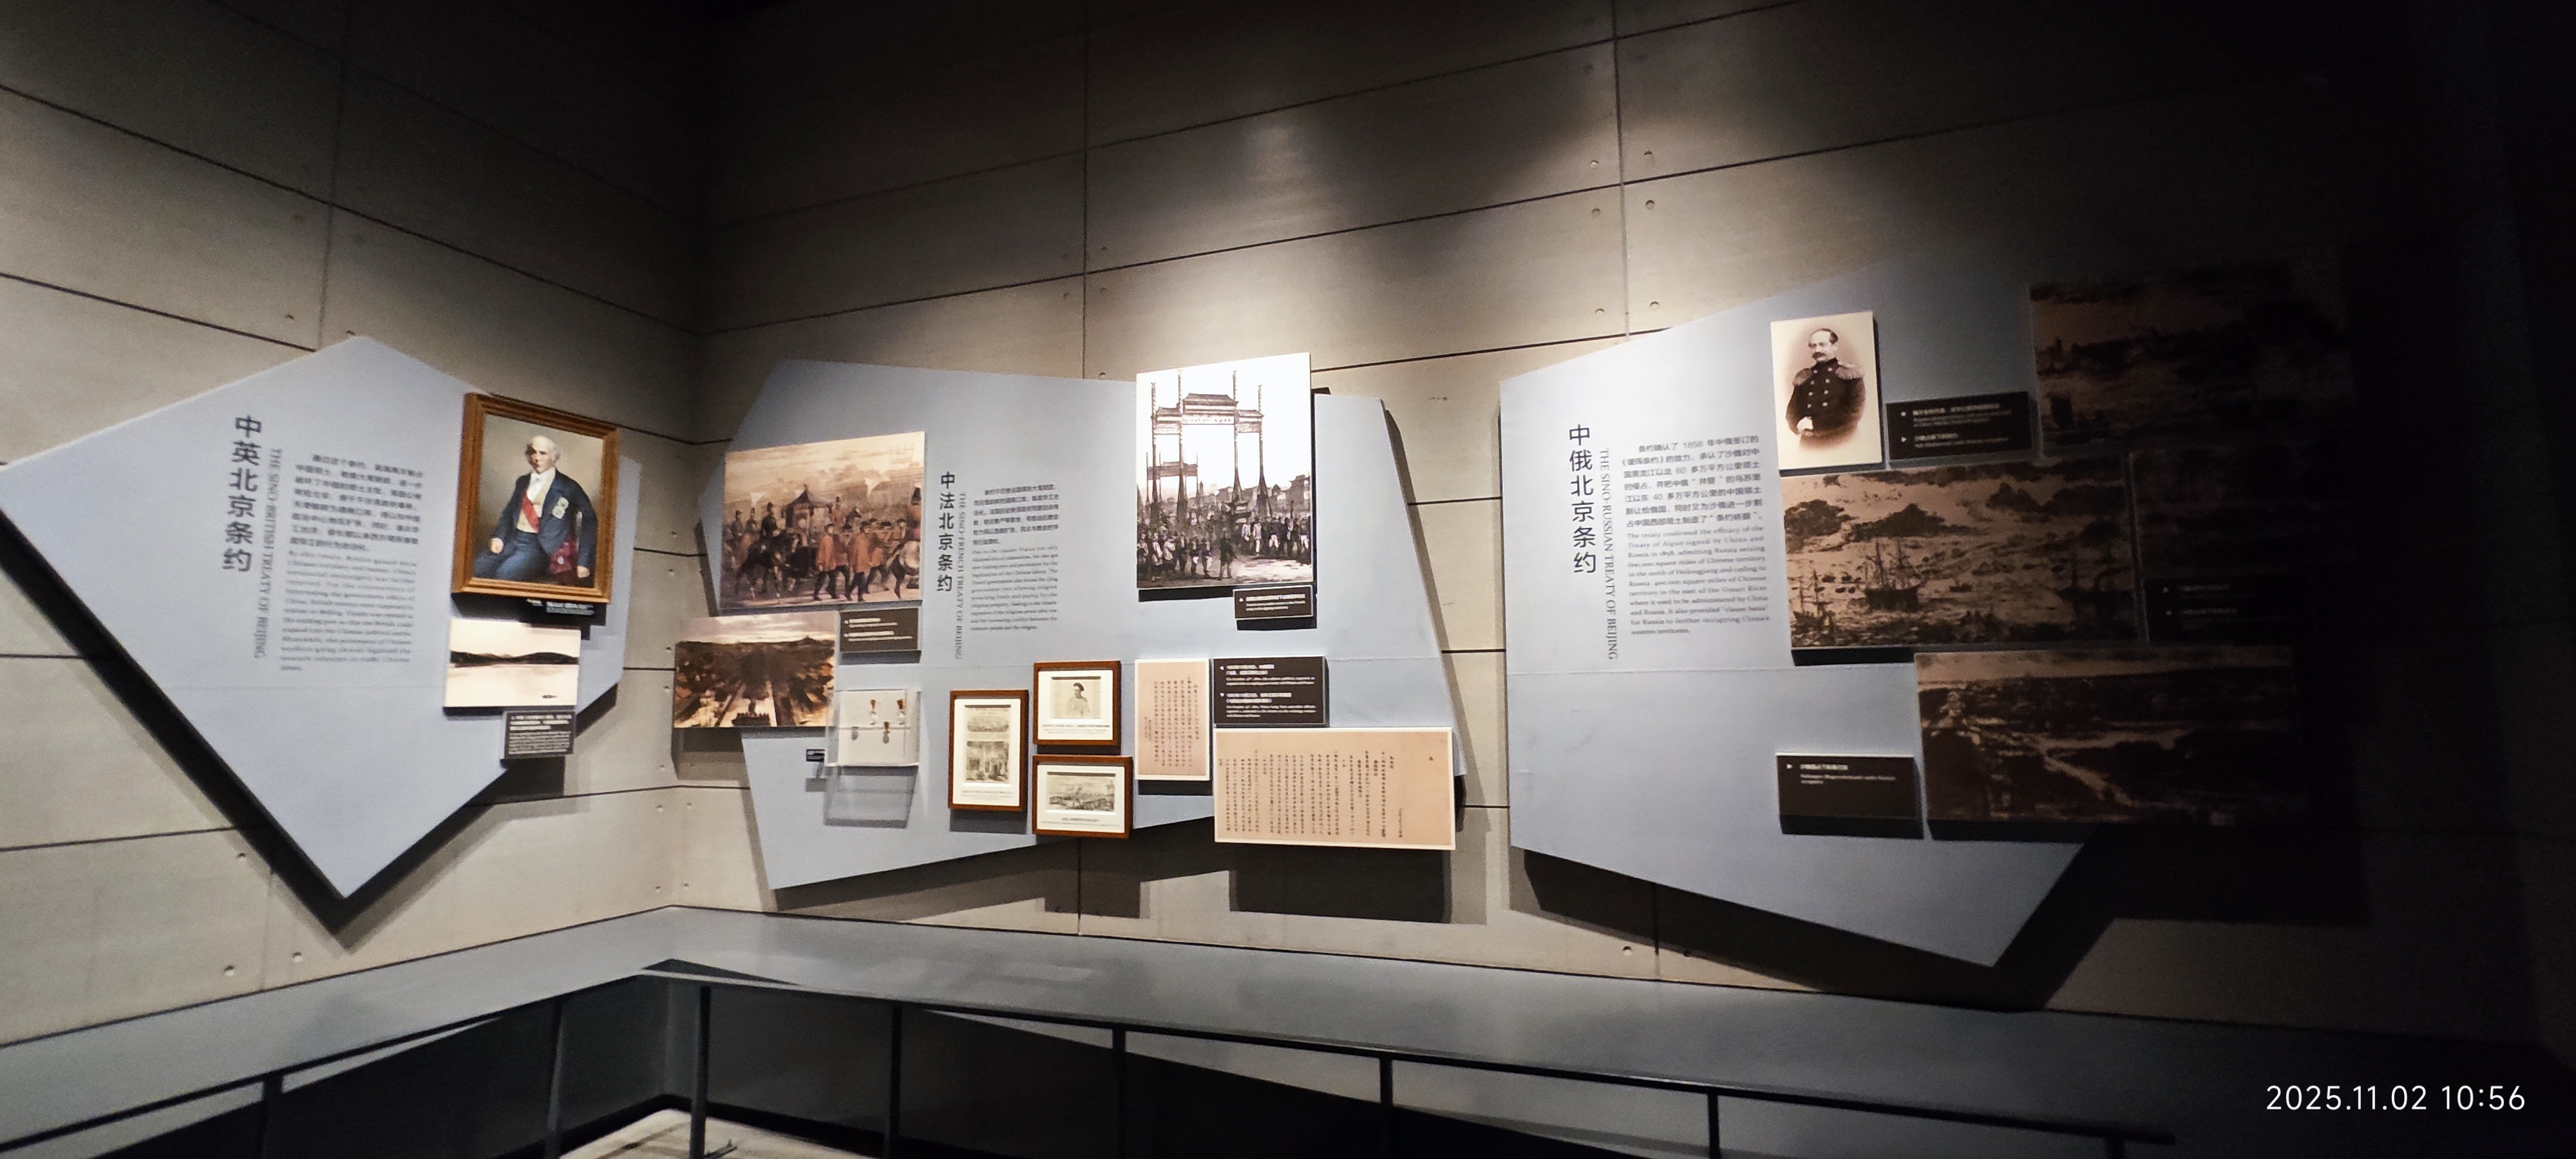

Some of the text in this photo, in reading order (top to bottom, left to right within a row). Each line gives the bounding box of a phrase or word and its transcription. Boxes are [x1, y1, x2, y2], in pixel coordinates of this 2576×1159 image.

[269, 449, 281, 469] THE
[222, 415, 262, 572] 中英北京条约
[1569, 424, 1596, 574] 中俄北京条约
[936, 471, 955, 592] 中法北京条约
[259, 552, 274, 594] TREATY
[1600, 448, 1618, 659] THE SINO-RUSSIAN TREATY OF BEIJING
[259, 597, 270, 612] OF
[956, 610, 963, 623] OF
[254, 616, 269, 658] BEIJING
